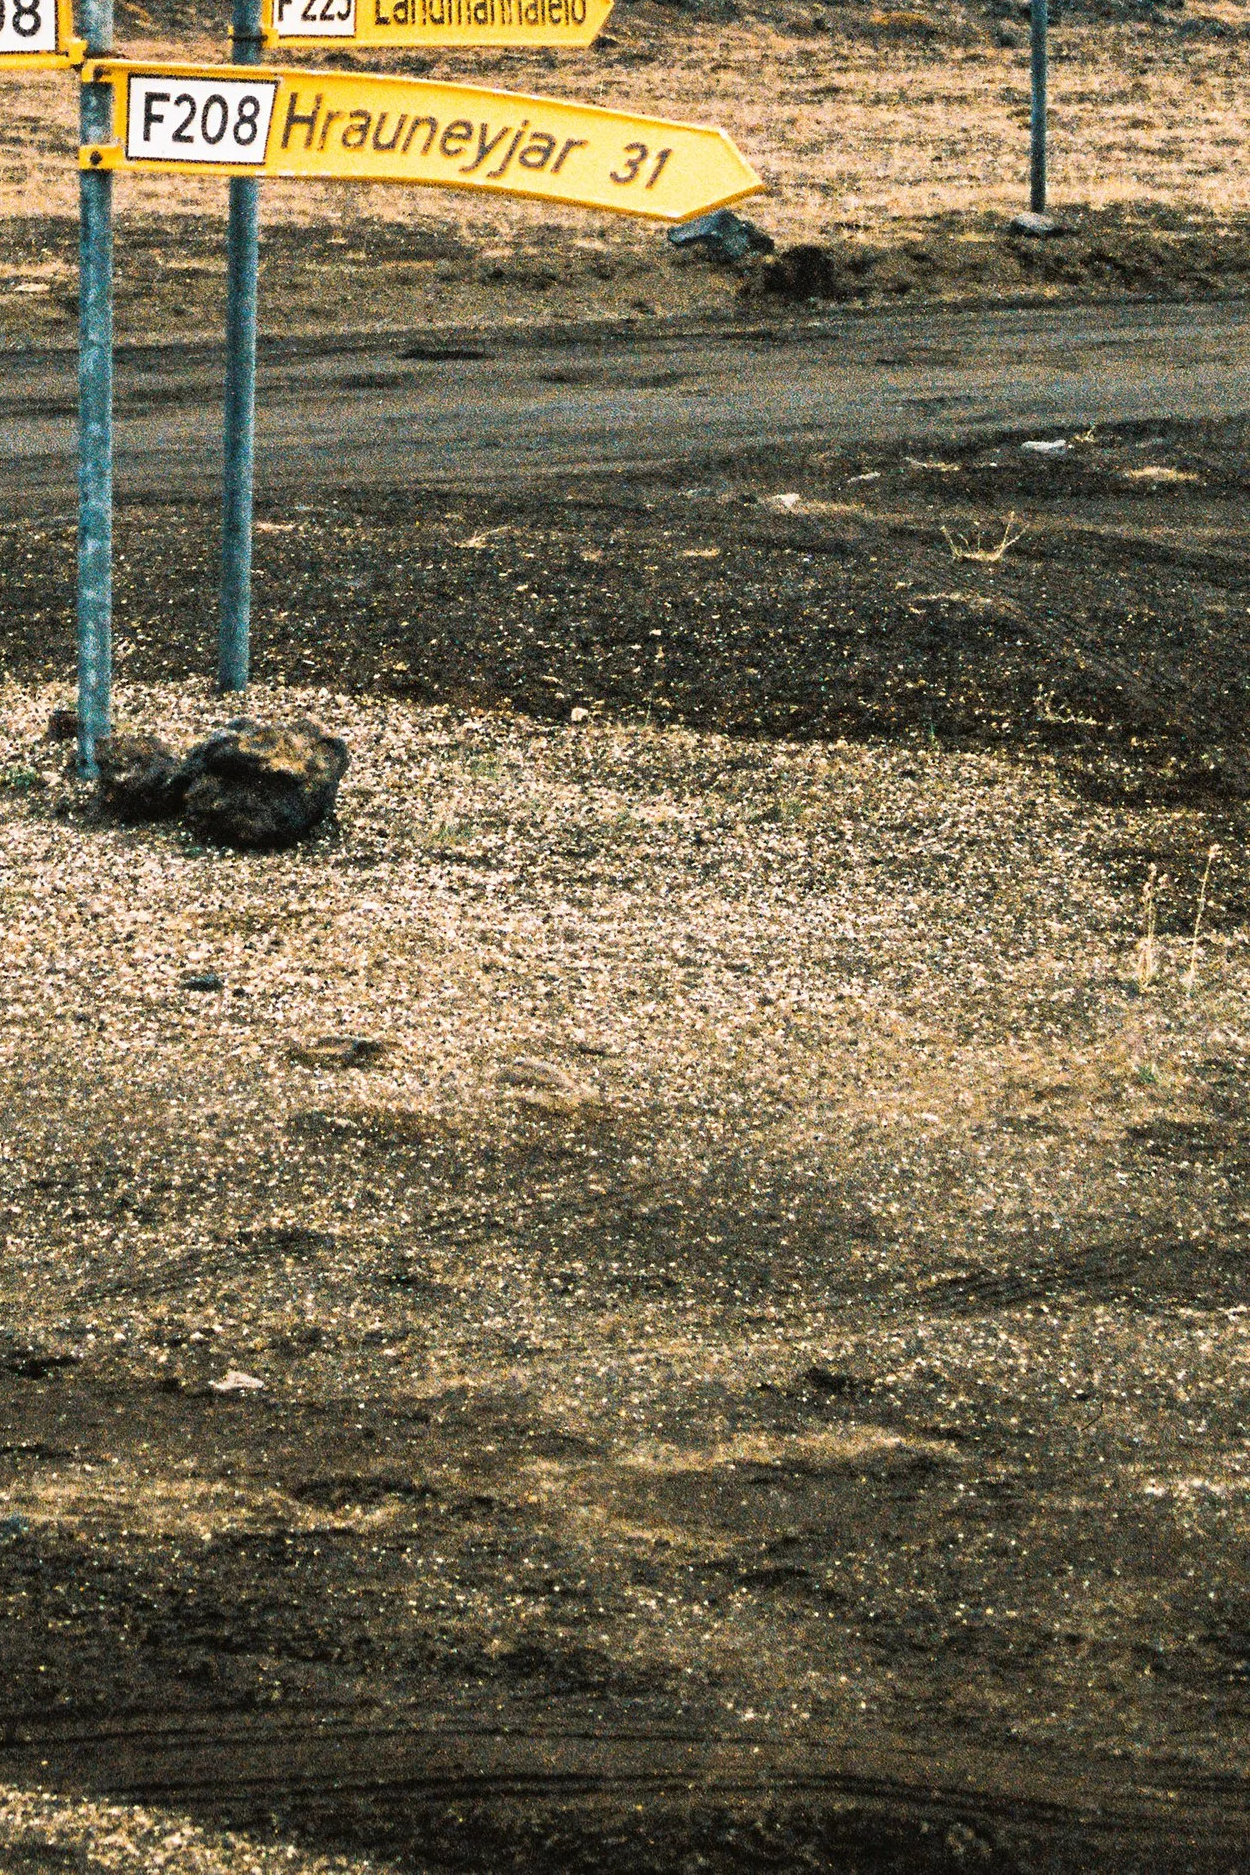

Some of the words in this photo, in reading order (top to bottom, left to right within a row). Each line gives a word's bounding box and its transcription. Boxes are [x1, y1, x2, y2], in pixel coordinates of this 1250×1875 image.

[143, 91, 261, 145] F208
[280, 91, 589, 178] Hrauneyjar
[608, 141, 673, 189] 31
